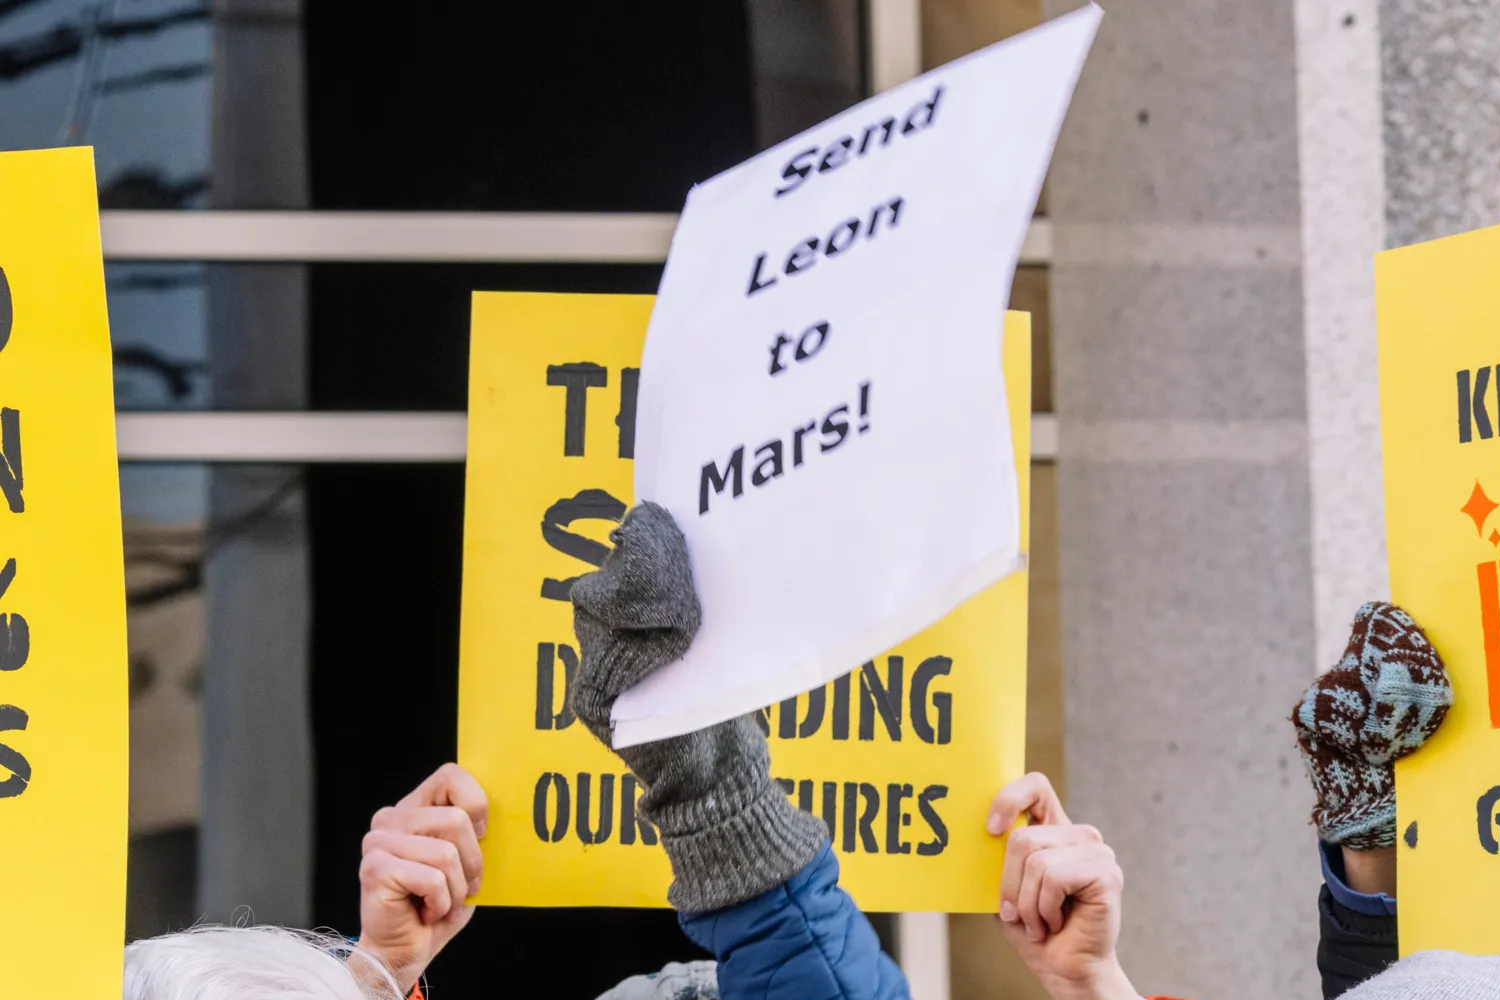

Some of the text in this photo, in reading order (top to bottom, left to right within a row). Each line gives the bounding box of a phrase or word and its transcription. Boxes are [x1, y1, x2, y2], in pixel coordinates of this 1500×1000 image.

[774, 84, 947, 198] Send
[744, 197, 905, 298] Leon
[767, 320, 830, 377] to
[698, 379, 873, 517] Mars!
[533, 771, 658, 846] OUR
